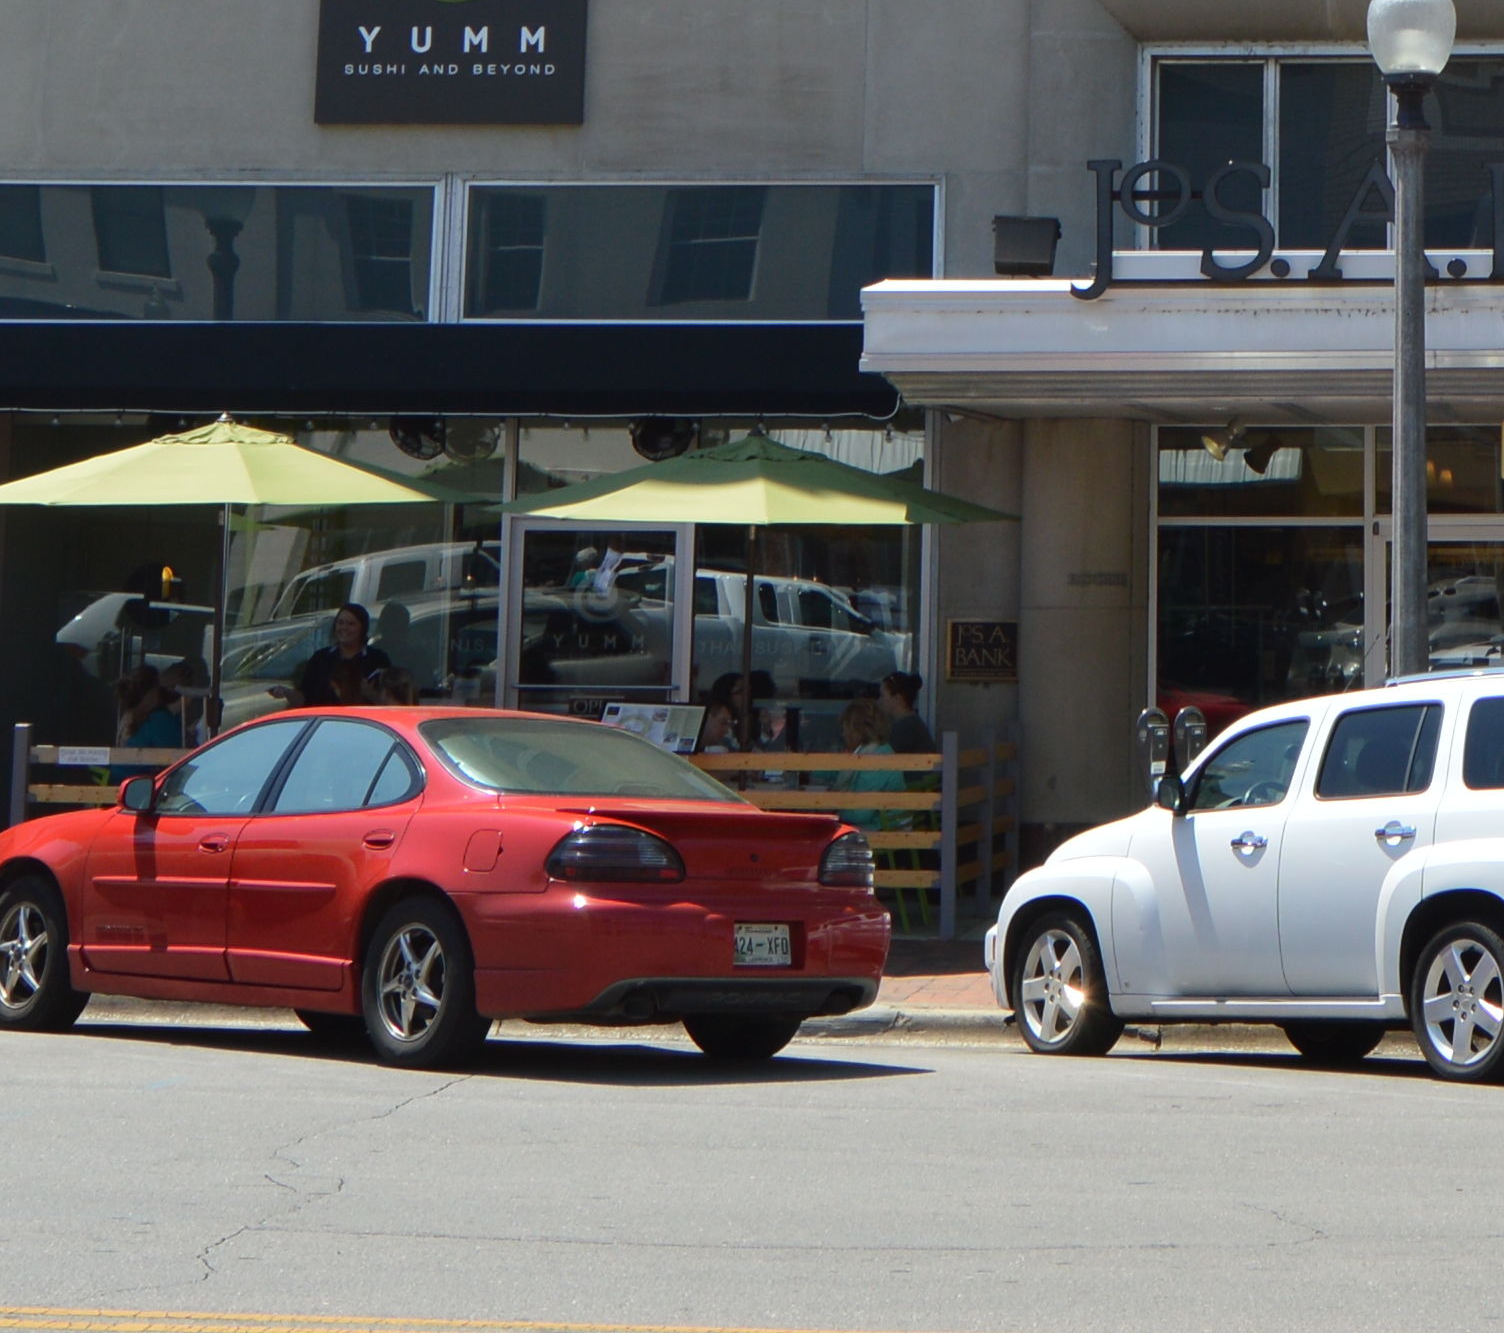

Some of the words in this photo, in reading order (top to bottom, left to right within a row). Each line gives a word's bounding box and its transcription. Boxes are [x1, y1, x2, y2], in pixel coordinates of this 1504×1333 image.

[358, 26, 546, 53] YUMM
[344, 64, 406, 75] SUSHI
[418, 64, 459, 75] AND
[472, 64, 556, 75] BEYOND
[955, 647, 1013, 667] BANK
